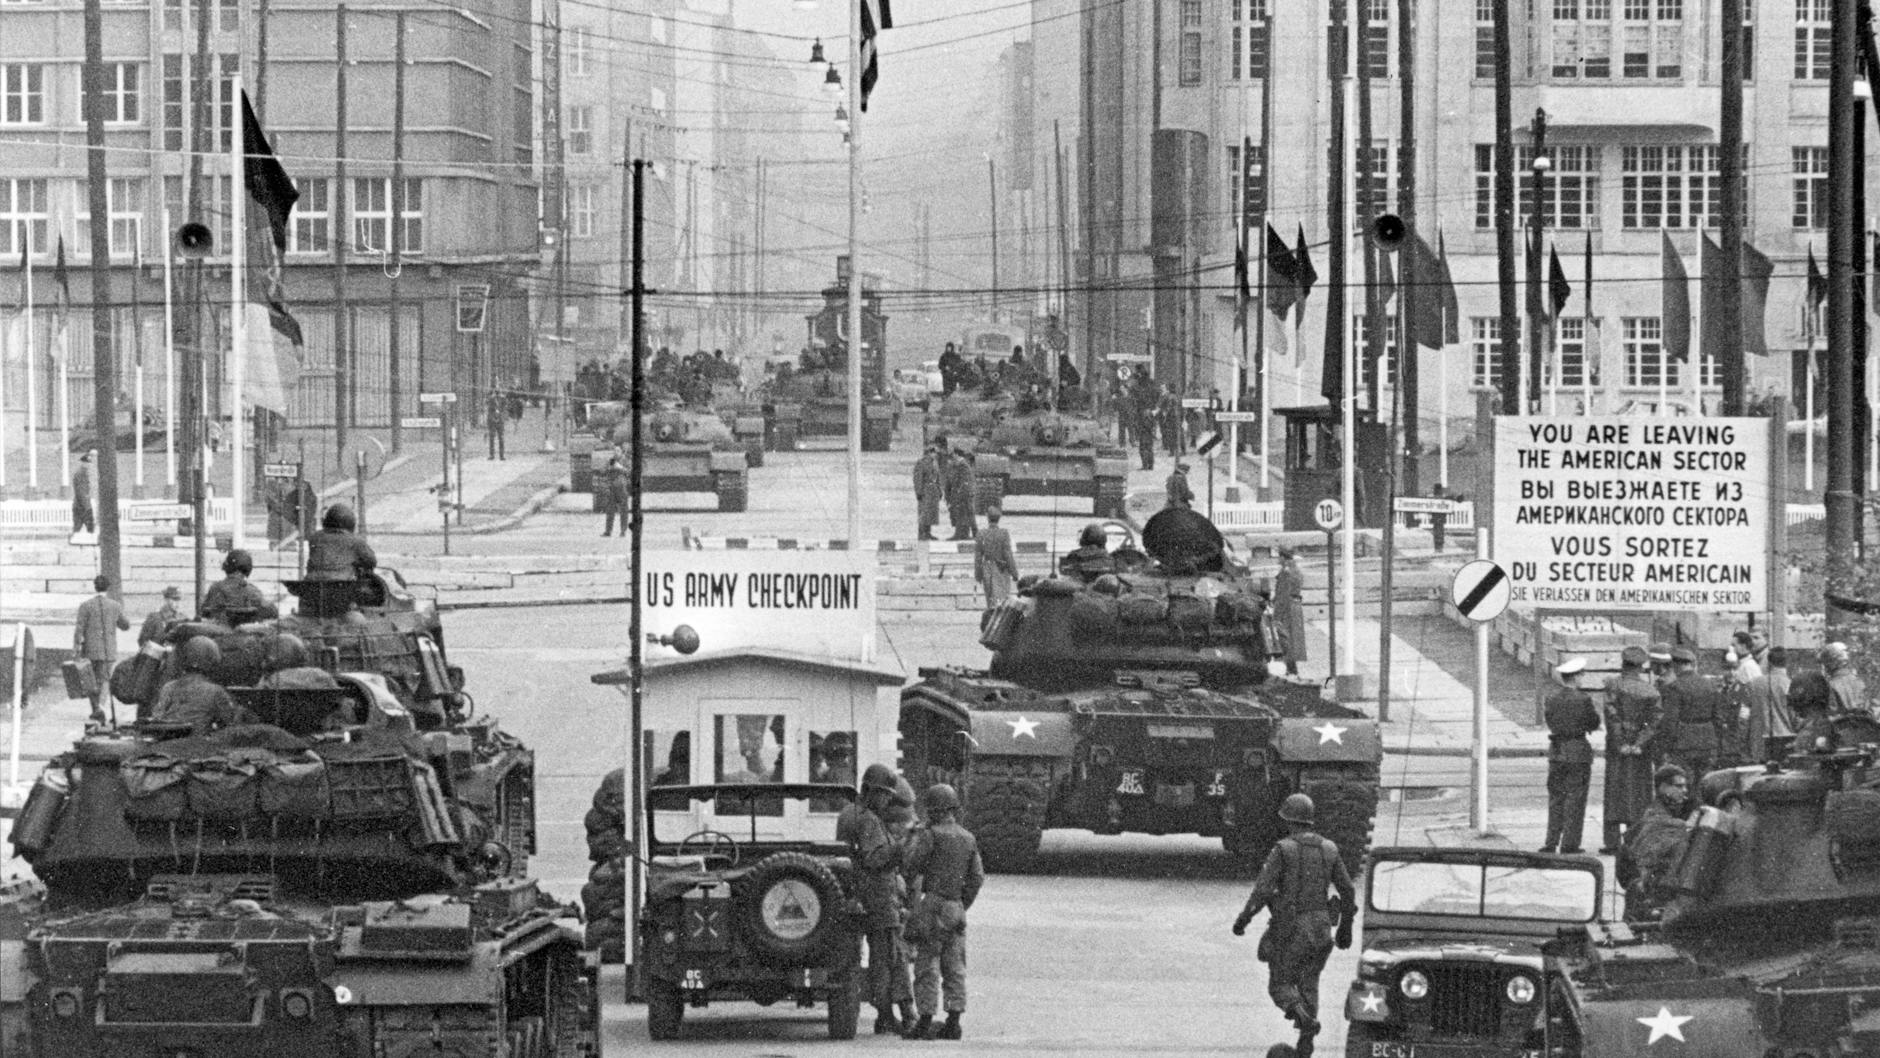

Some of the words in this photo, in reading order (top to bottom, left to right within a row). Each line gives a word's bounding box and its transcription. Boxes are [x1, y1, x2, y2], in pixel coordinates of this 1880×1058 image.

[1530, 424, 1572, 443] YOU
[1587, 425, 1628, 444] ARE
[1644, 426, 1734, 445] LEAVING
[1518, 450, 1550, 468] THE
[1562, 450, 1661, 470] AMERICAN
[1674, 451, 1746, 470] SECTOR
[1522, 480, 1553, 499] ВЫ
[1568, 480, 1700, 500] ВЫЕЗЖАЕТЕ
[1716, 482, 1742, 501] ИЗ
[1319, 504, 1333, 523] 10
[1517, 506, 1664, 525] АМЕРИКАНСКОГО
[1673, 506, 1748, 526] СЕКТОРА
[1551, 536, 1611, 556] VOUS
[1626, 537, 1708, 557] SORTEZ
[1513, 562, 1536, 581] DU
[1549, 562, 1634, 582] SECTEUR
[1645, 564, 1750, 583] AMERICAIN
[647, 572, 673, 607] US
[686, 573, 737, 606] ARMY
[749, 573, 861, 609] CHECKPOINT
[1512, 587, 1528, 601] SIE
[1533, 588, 1590, 602] VERLASSEN
[1596, 589, 1614, 602] DEN
[1620, 590, 1708, 604] AMERIKANISCHEN
[1714, 591, 1750, 604] SEKTOR
